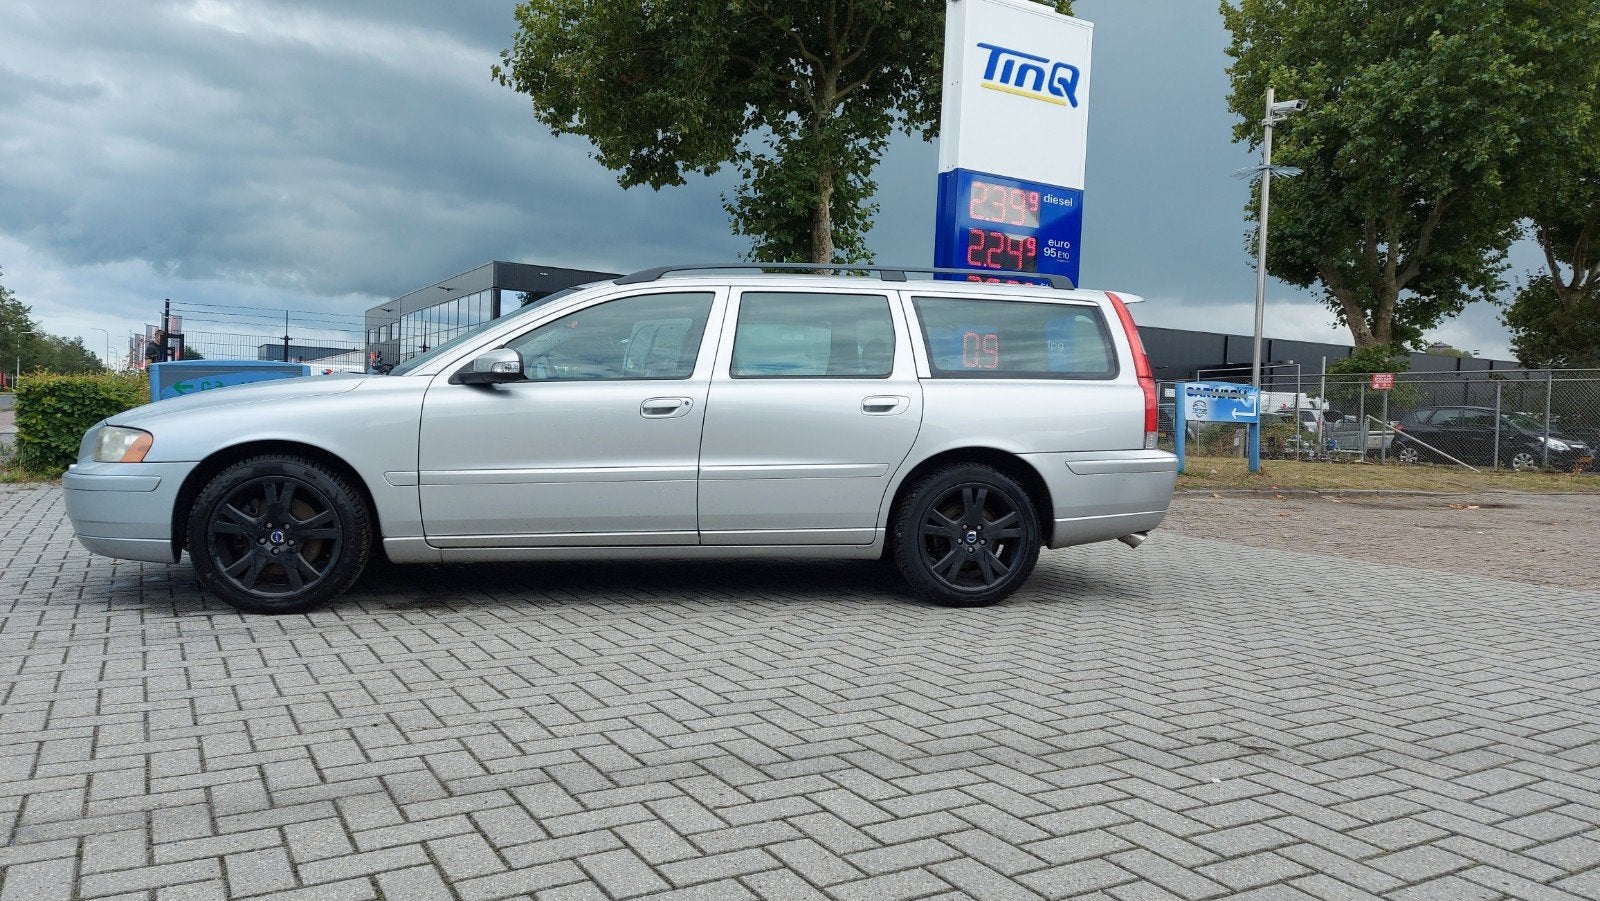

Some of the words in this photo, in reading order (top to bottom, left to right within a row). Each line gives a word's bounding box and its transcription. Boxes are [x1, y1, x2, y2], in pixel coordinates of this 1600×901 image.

[1043, 194, 1073, 207] diesel
[1048, 239, 1071, 249] euro
[1043, 247, 1057, 258] 95
[1057, 252, 1070, 260] E10
[1047, 340, 1064, 352] lpg
